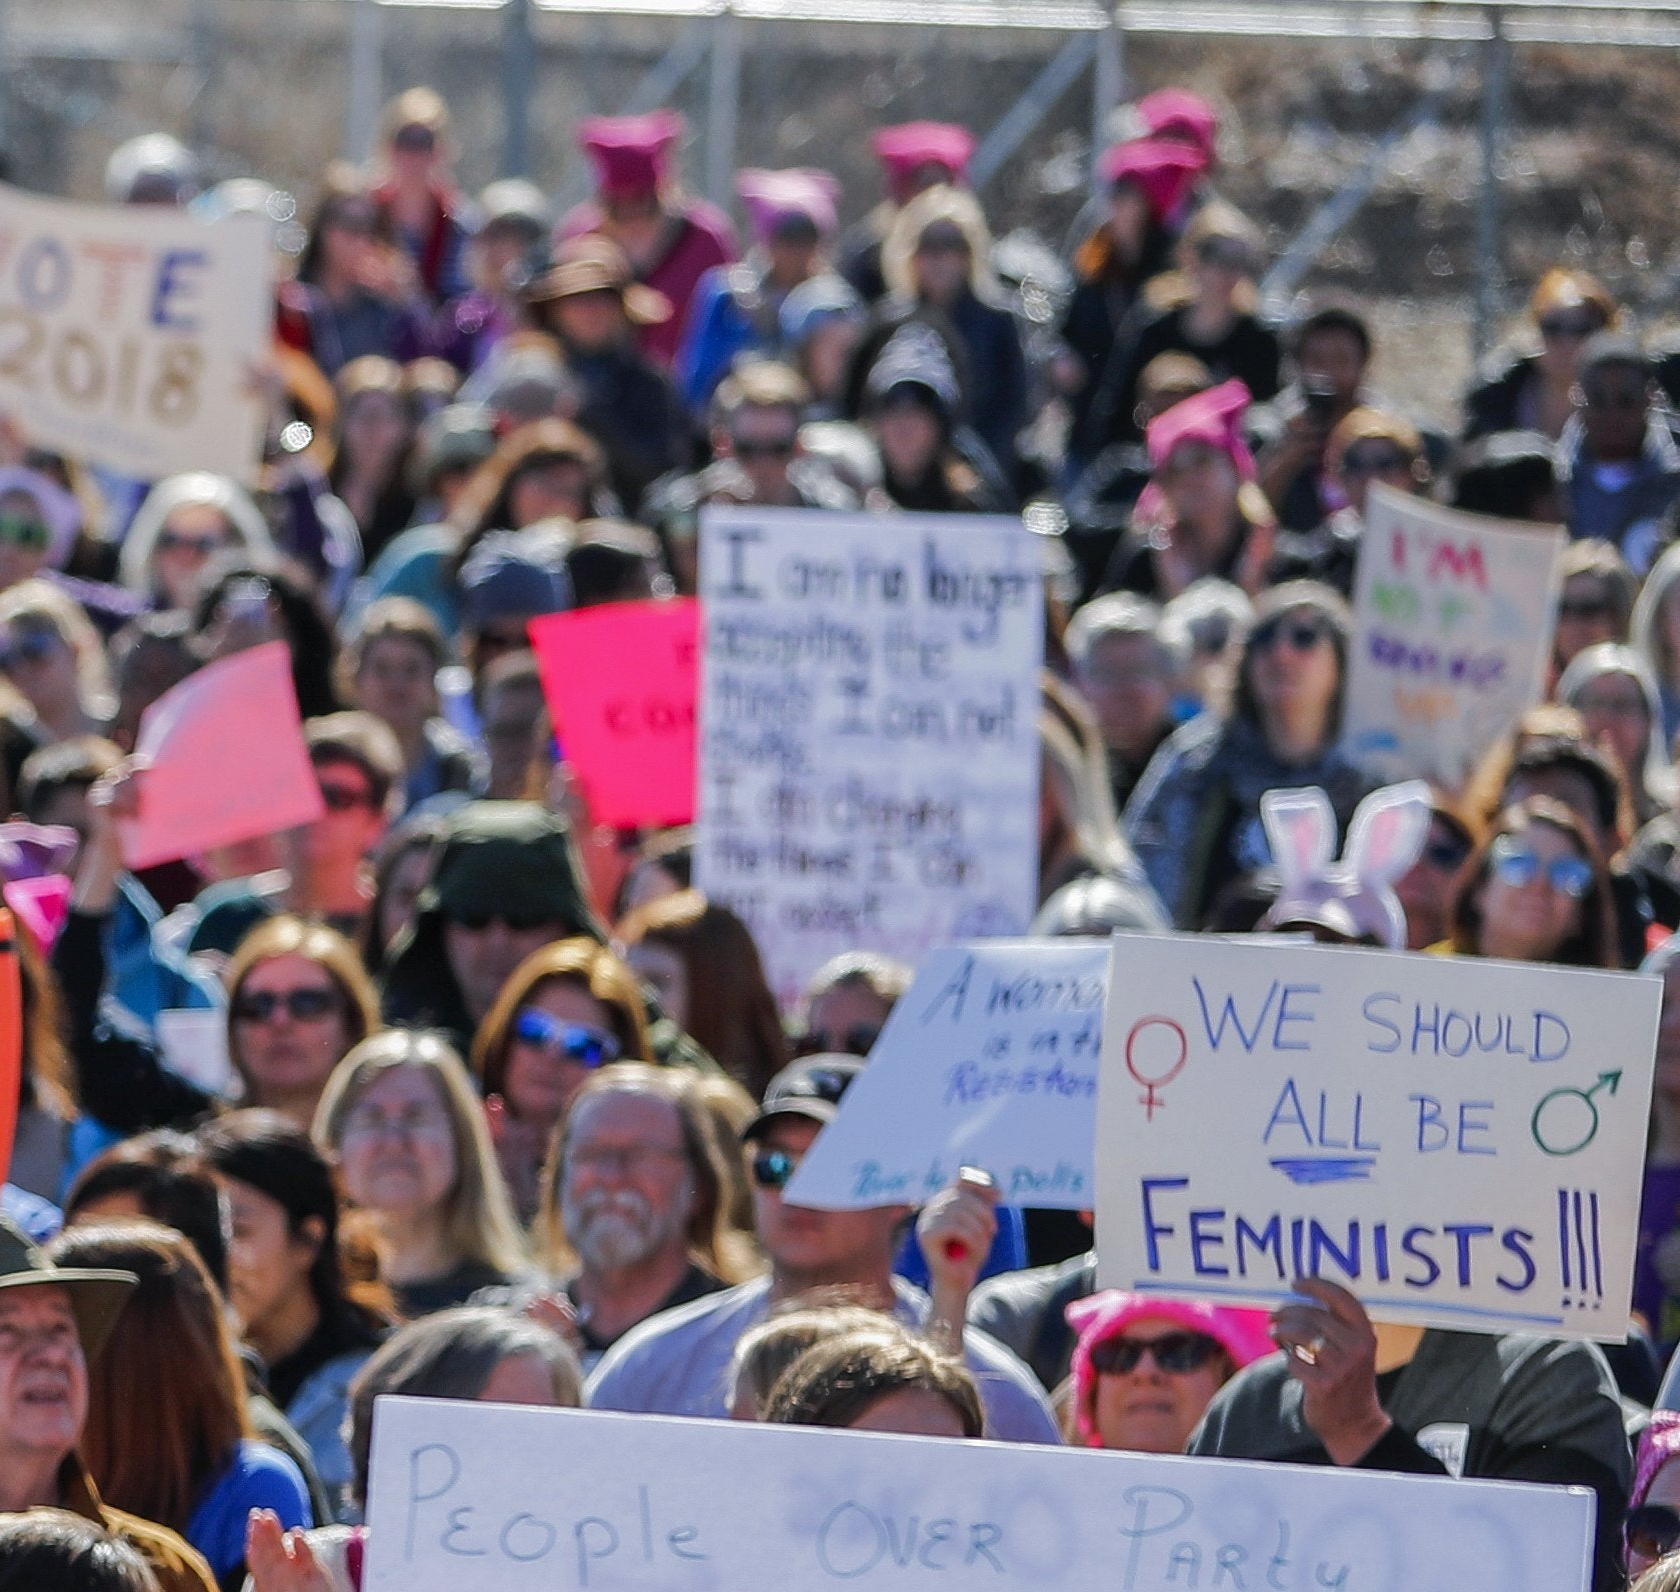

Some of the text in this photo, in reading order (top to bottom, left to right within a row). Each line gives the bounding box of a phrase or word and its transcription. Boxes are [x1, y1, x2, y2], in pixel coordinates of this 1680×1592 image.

[715, 526, 765, 599] I
[1190, 974, 1573, 1064] WE SHOULD
[1261, 1077, 1499, 1158] ALL BE
[813, 1496, 1009, 1583] OVER
